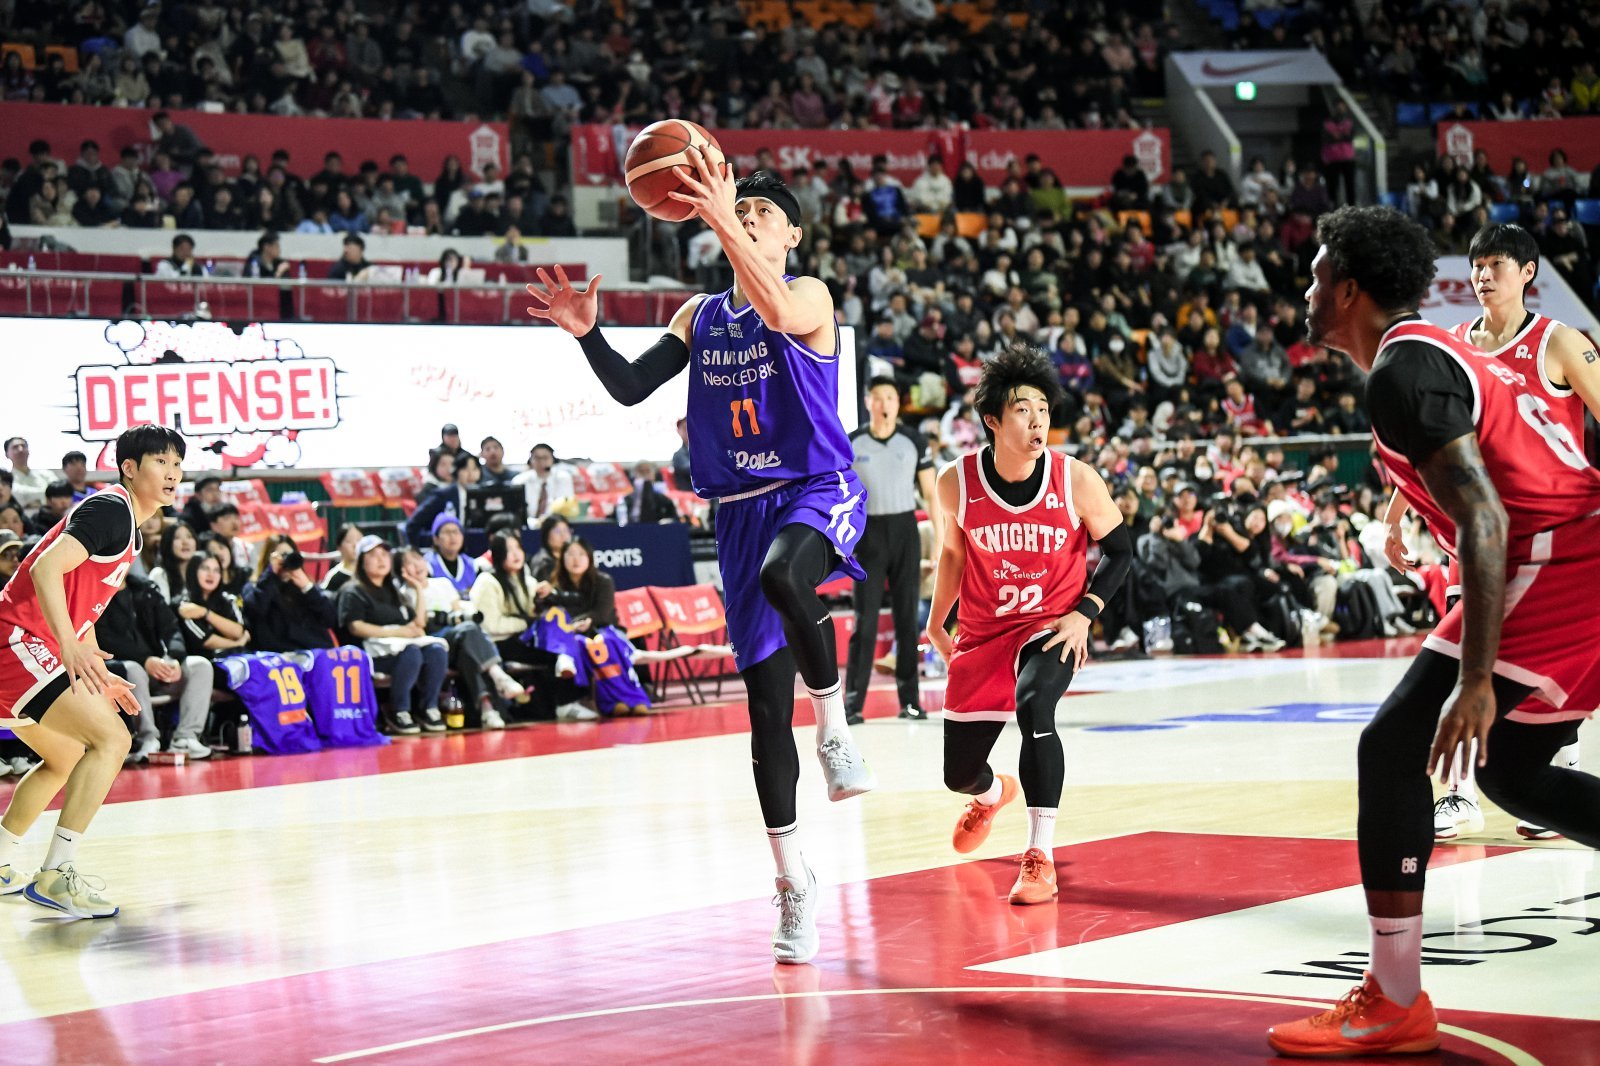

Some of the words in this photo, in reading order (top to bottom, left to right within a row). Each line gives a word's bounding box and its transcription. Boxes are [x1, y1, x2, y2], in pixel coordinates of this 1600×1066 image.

[779, 146, 812, 169] SK
[702, 341, 769, 365] SAMUNG
[703, 371, 732, 386] Neo
[758, 360, 779, 380] 8K
[85, 367, 331, 431] DEFENSE!
[730, 398, 761, 438] 11
[1516, 393, 1591, 471] 6
[970, 522, 1068, 555] KNIGHTS
[593, 547, 643, 569] PORTS
[993, 569, 1010, 580] SK
[1013, 567, 1049, 581] telecom
[995, 584, 1045, 618] 22
[268, 666, 306, 706] 19
[331, 665, 362, 705] 11
[1401, 857, 1418, 874] 86
